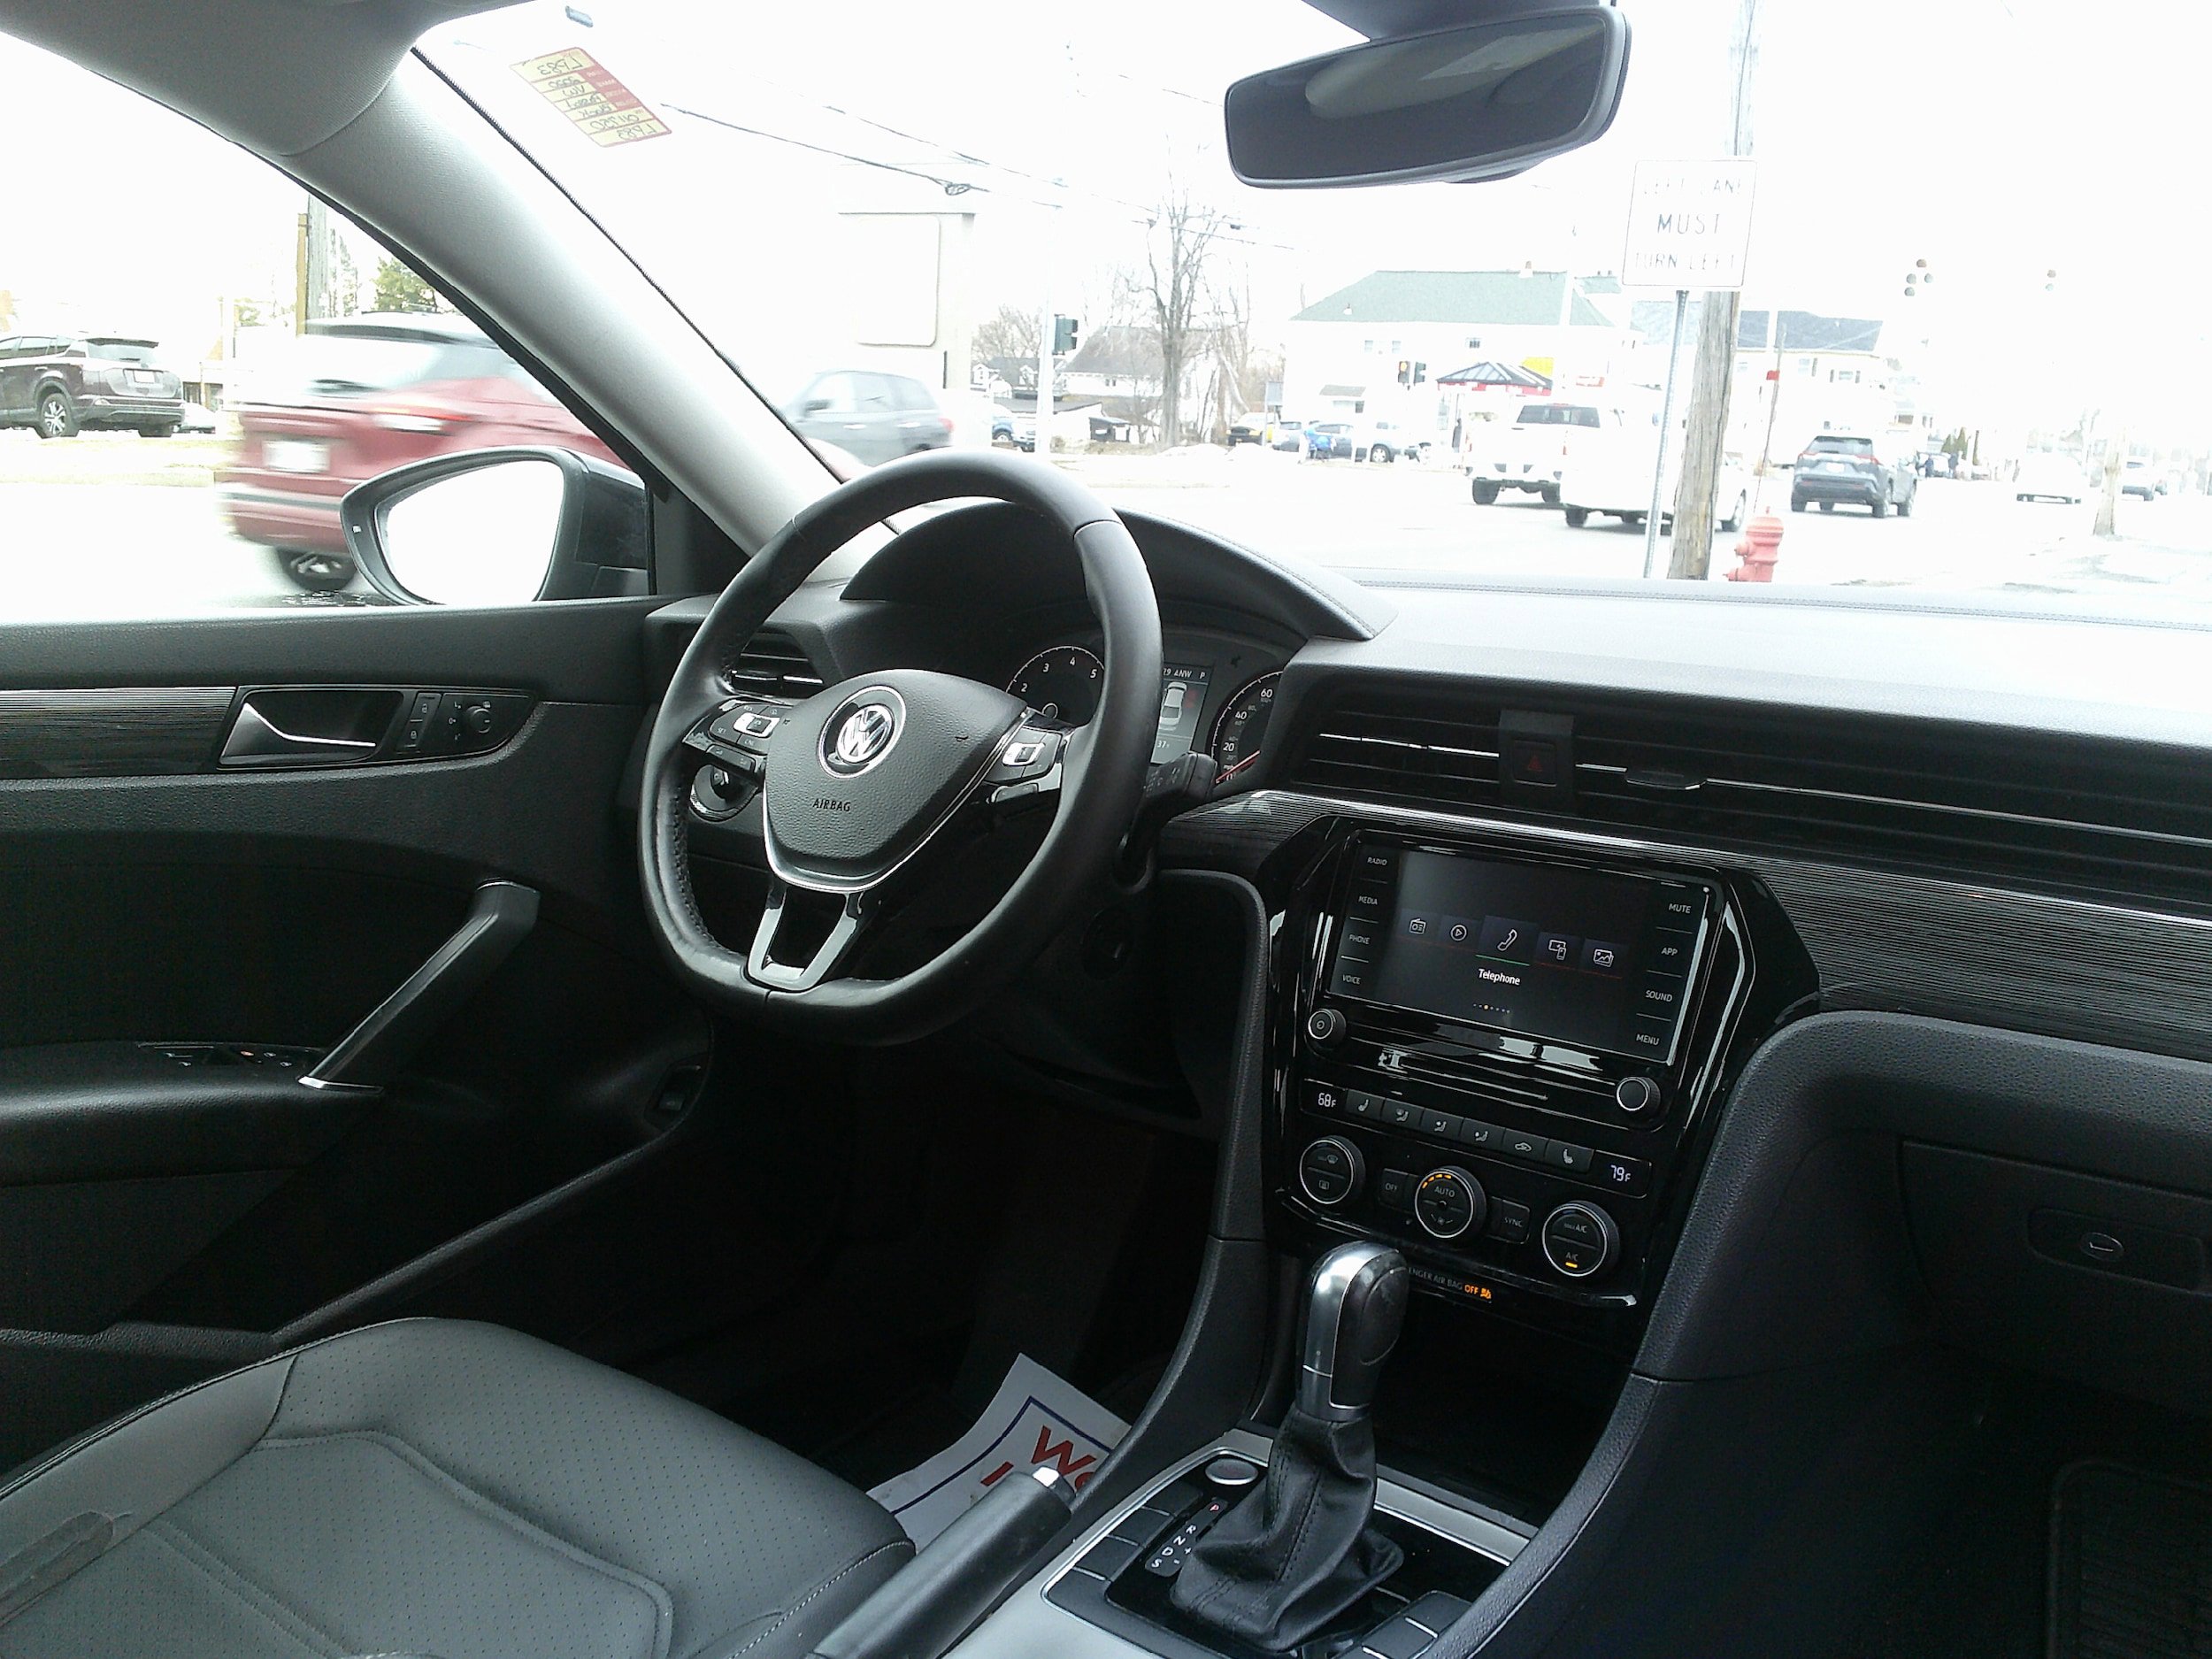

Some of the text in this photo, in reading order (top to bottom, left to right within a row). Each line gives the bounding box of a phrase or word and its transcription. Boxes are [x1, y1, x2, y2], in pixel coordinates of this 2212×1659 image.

[1656, 213, 1721, 234] MUST
[1069, 657, 1076, 666] 4
[1042, 663, 1050, 672] 3
[1089, 669, 1097, 679] 5
[1020, 683, 1028, 693] 2
[1260, 688, 1273, 698] 60
[1234, 710, 1248, 720] 40
[1223, 741, 1235, 752] 20
[812, 797, 851, 812] AIRBAG
[1367, 856, 1387, 866] RADIO
[1357, 895, 1379, 906] MEDIA
[1668, 902, 1692, 914] MUTE
[1348, 933, 1371, 945] PHONE
[1661, 946, 1678, 957] APP
[1341, 973, 1362, 986] VOICE
[1478, 968, 1521, 986] Telephone
[1645, 989, 1673, 1002] SOUND
[1636, 1033, 1660, 1046] MENU
[1434, 1186, 1455, 1198] AUTO
[1503, 1217, 1524, 1228] SYNC
[1464, 1284, 1479, 1295] OFF
[1186, 1525, 1197, 1534] R
[1172, 1535, 1187, 1546] N
[1161, 1546, 1174, 1556] D
[1151, 1558, 1163, 1568] S
